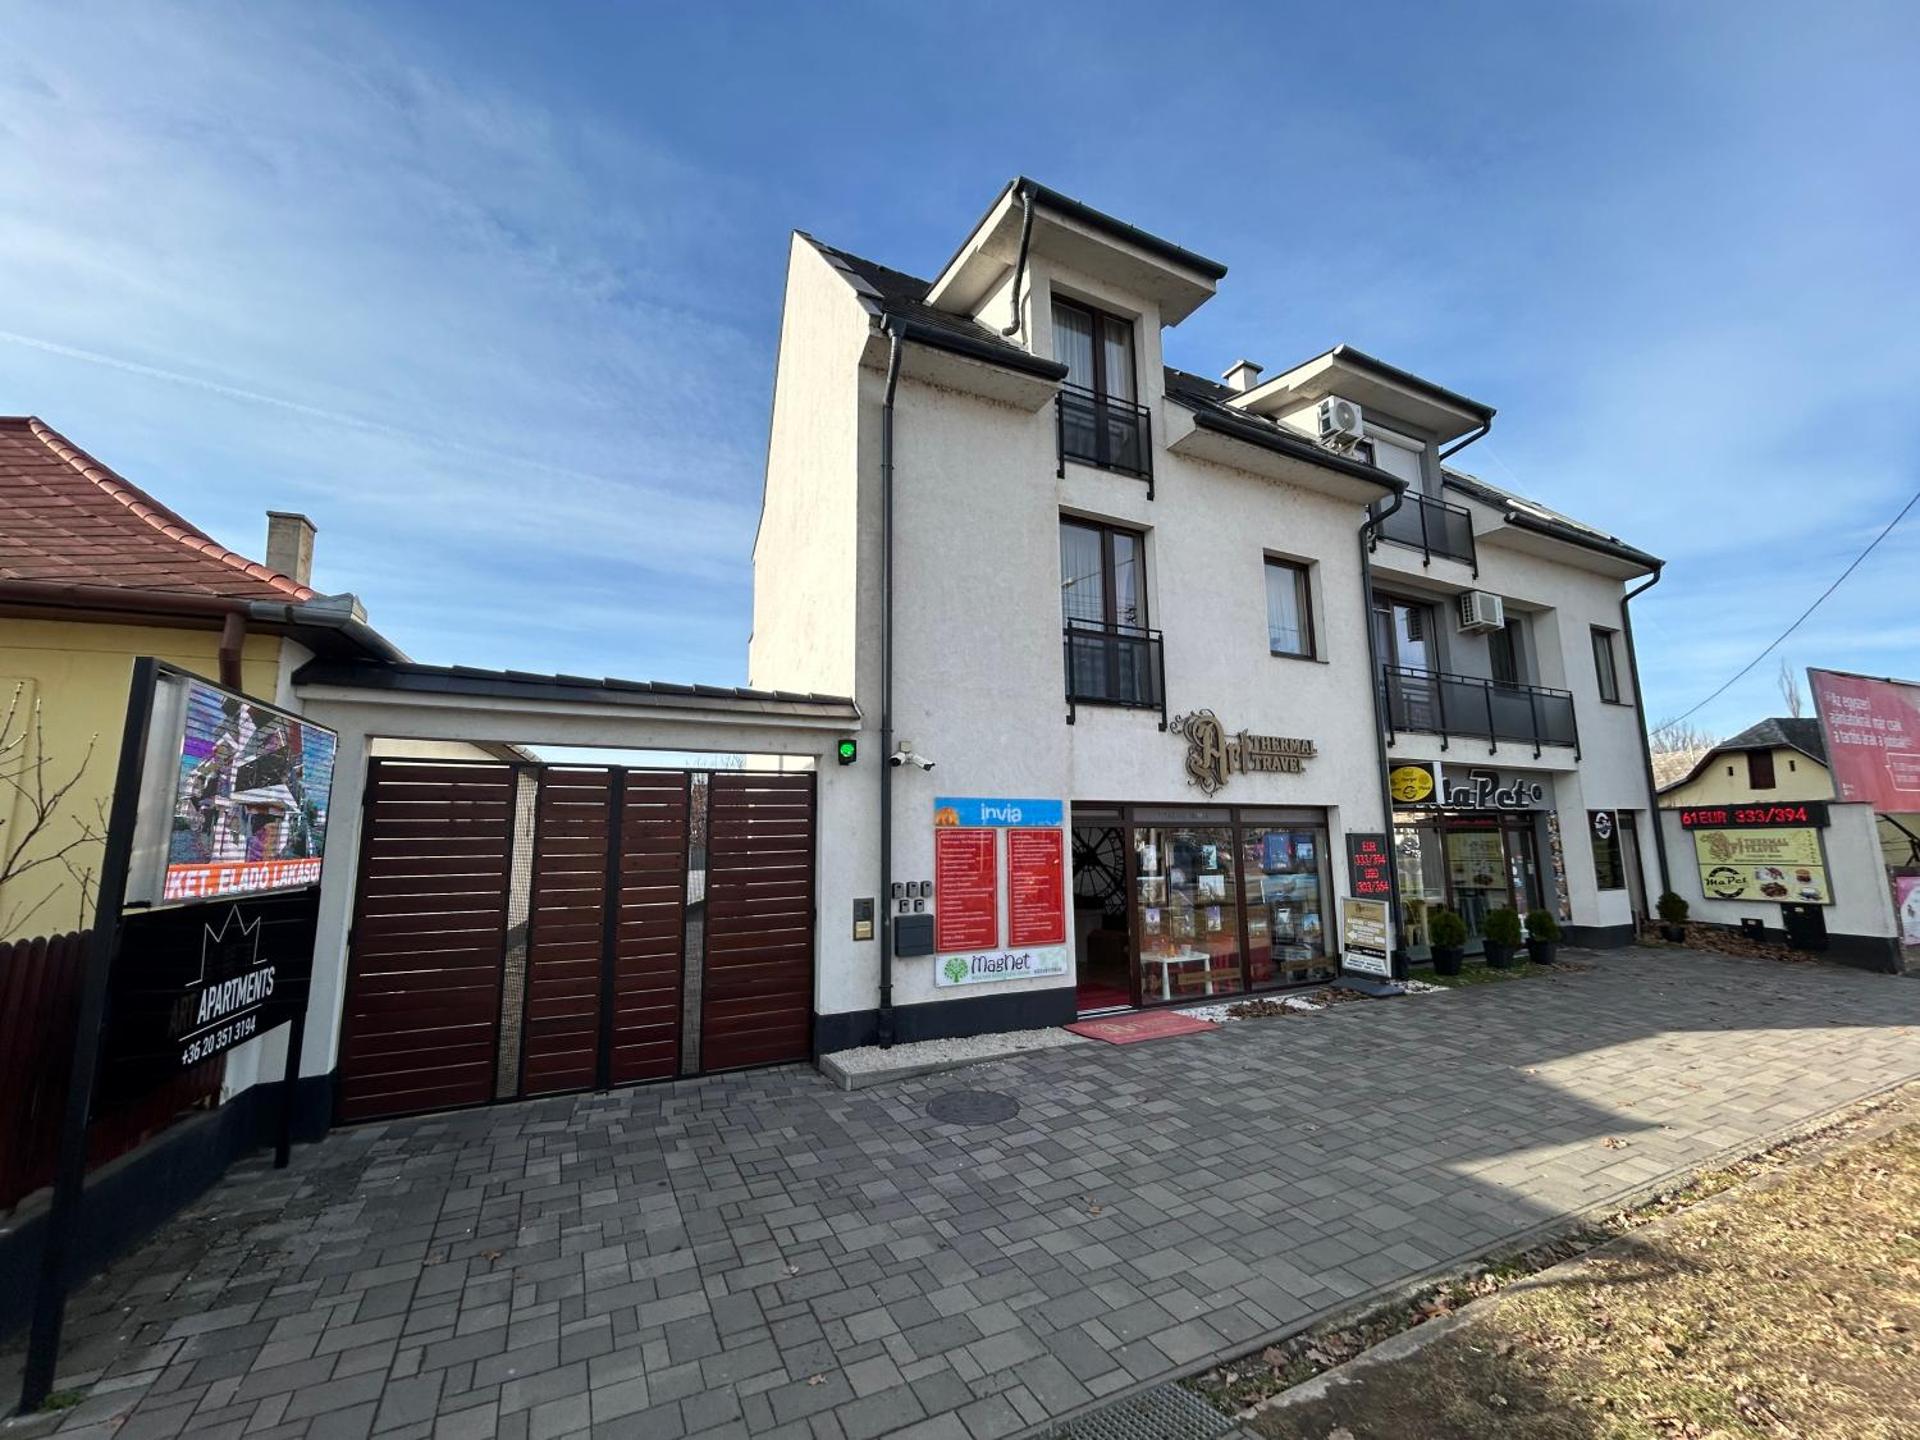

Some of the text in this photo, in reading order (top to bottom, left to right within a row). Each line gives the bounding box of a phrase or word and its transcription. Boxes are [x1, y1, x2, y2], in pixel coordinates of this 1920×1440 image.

[1178, 708, 1249, 797] Art
[1250, 735, 1318, 755] THERMAL
[1252, 755, 1306, 773] TRAVEL
[980, 803, 1022, 823] invia
[218, 861, 271, 894] ELADÓ
[273, 858, 321, 888] LAKÁSO
[196, 965, 276, 1025] APARTMENTS
[182, 1015, 257, 1065] +36 20 351 3194
